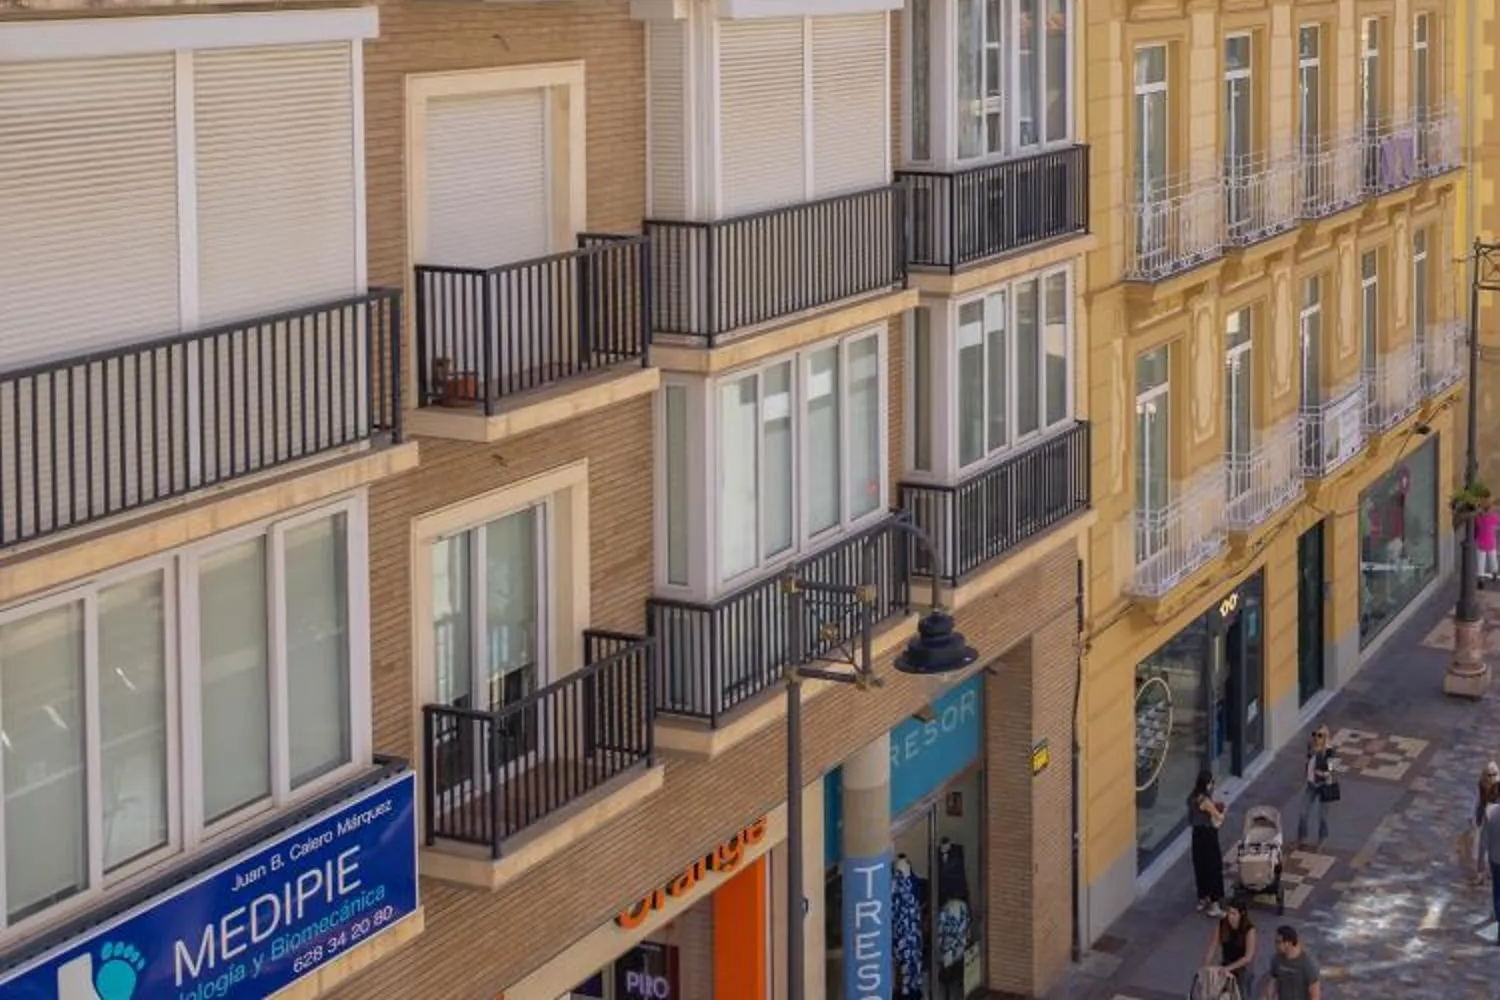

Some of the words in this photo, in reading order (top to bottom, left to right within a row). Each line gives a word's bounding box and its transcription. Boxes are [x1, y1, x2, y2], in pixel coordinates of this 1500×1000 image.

[891, 689, 975, 766] RESOR
[232, 863, 267, 892] Juan
[289, 831, 333, 861] Calero
[175, 845, 362, 987] MEDIPIE
[853, 863, 884, 1000] TRES
[252, 952, 265, 979] y
